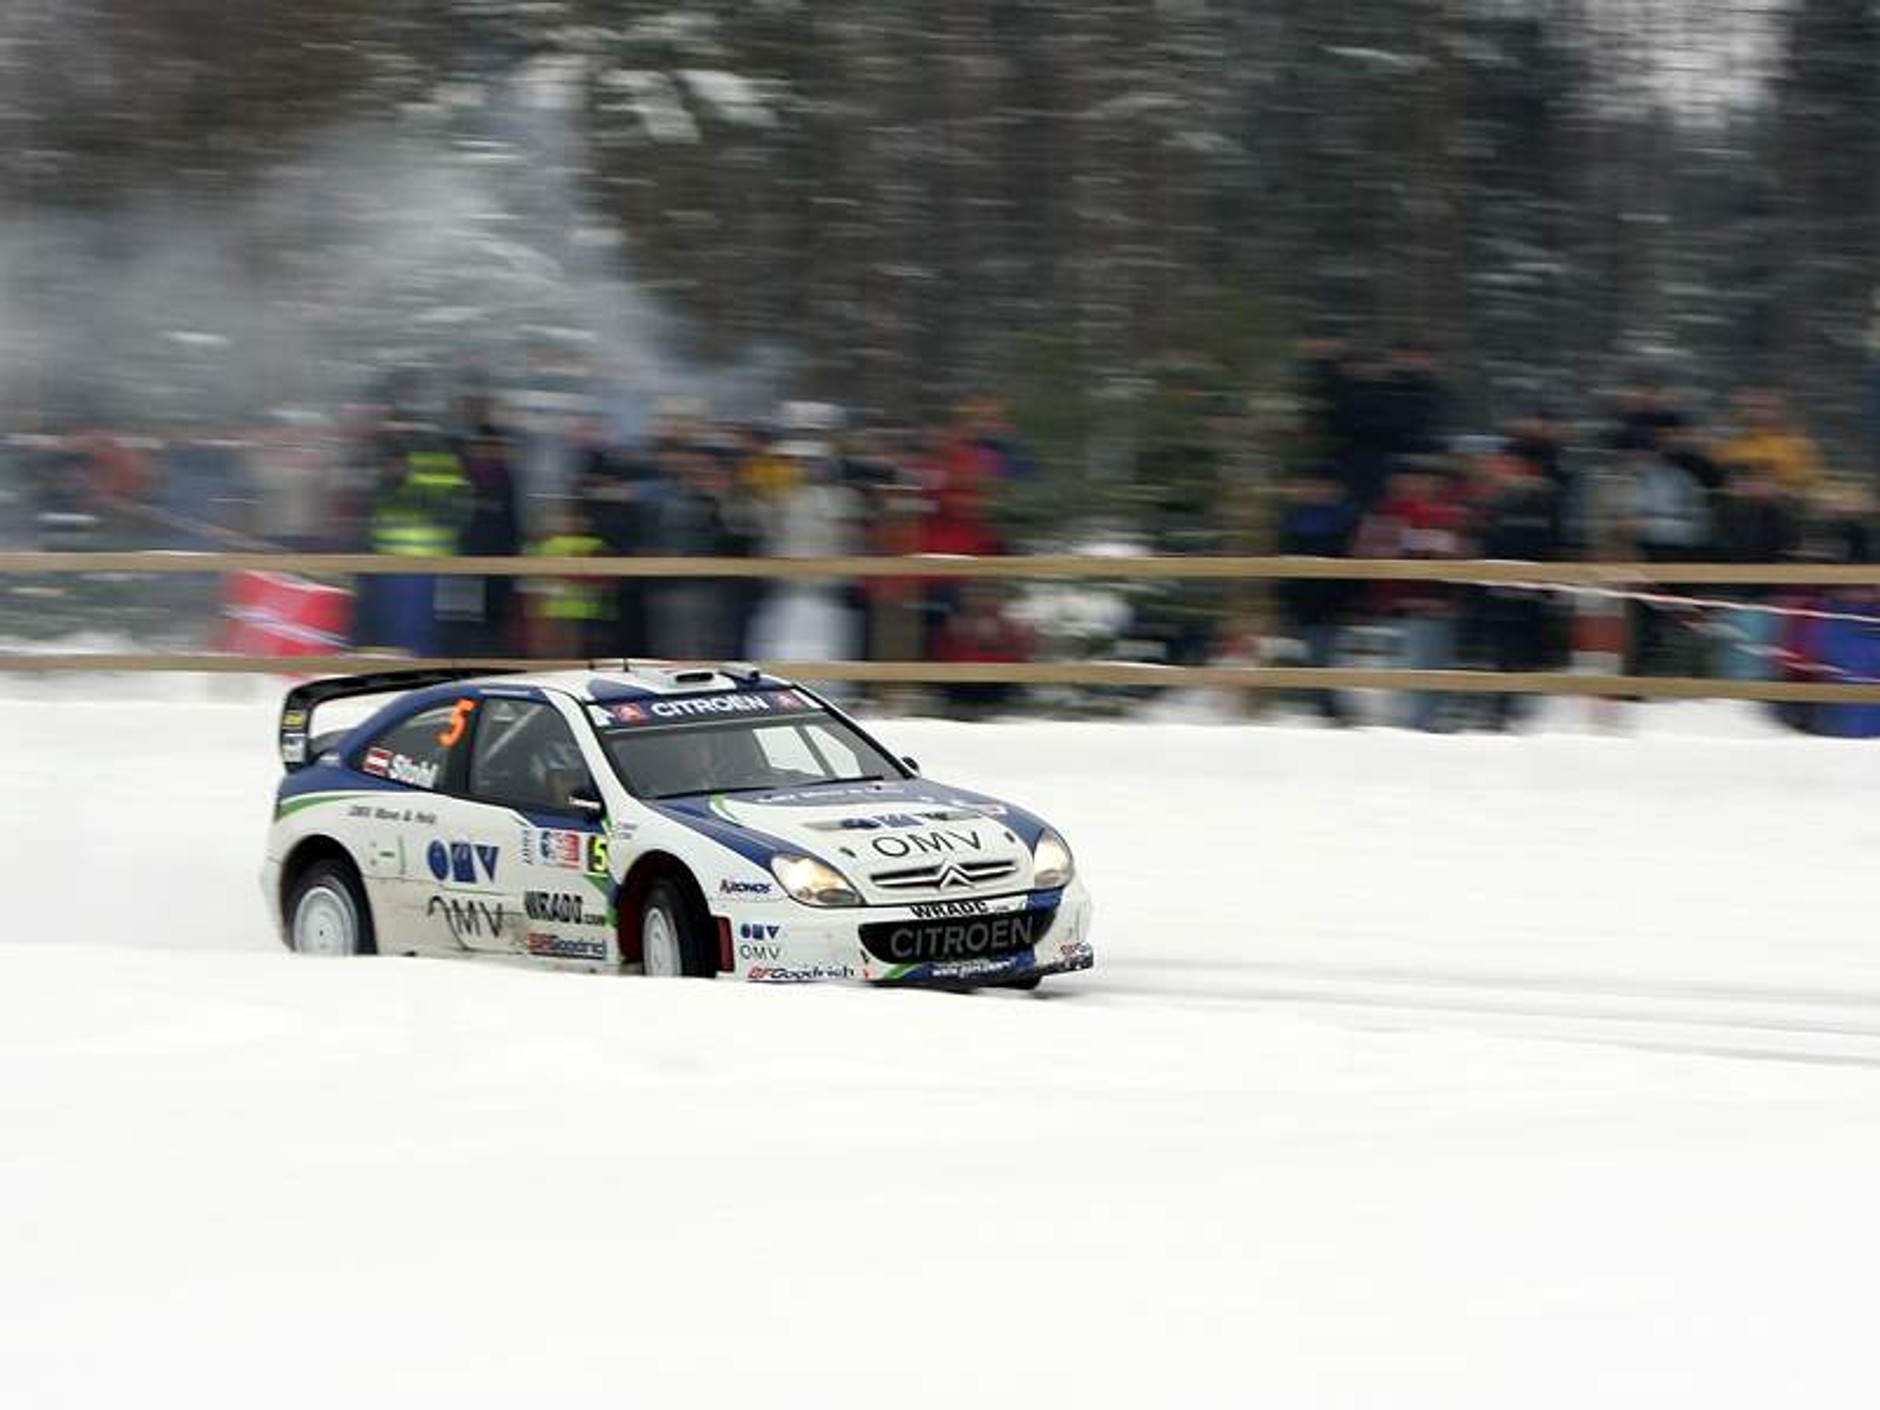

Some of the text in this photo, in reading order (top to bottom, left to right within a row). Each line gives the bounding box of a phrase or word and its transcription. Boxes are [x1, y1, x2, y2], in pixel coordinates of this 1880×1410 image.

[437, 697, 475, 747] 5
[593, 835, 607, 873] 5
[871, 831, 982, 858] OMV
[740, 944, 780, 960] OMV
[890, 914, 1033, 957] CITROEN
